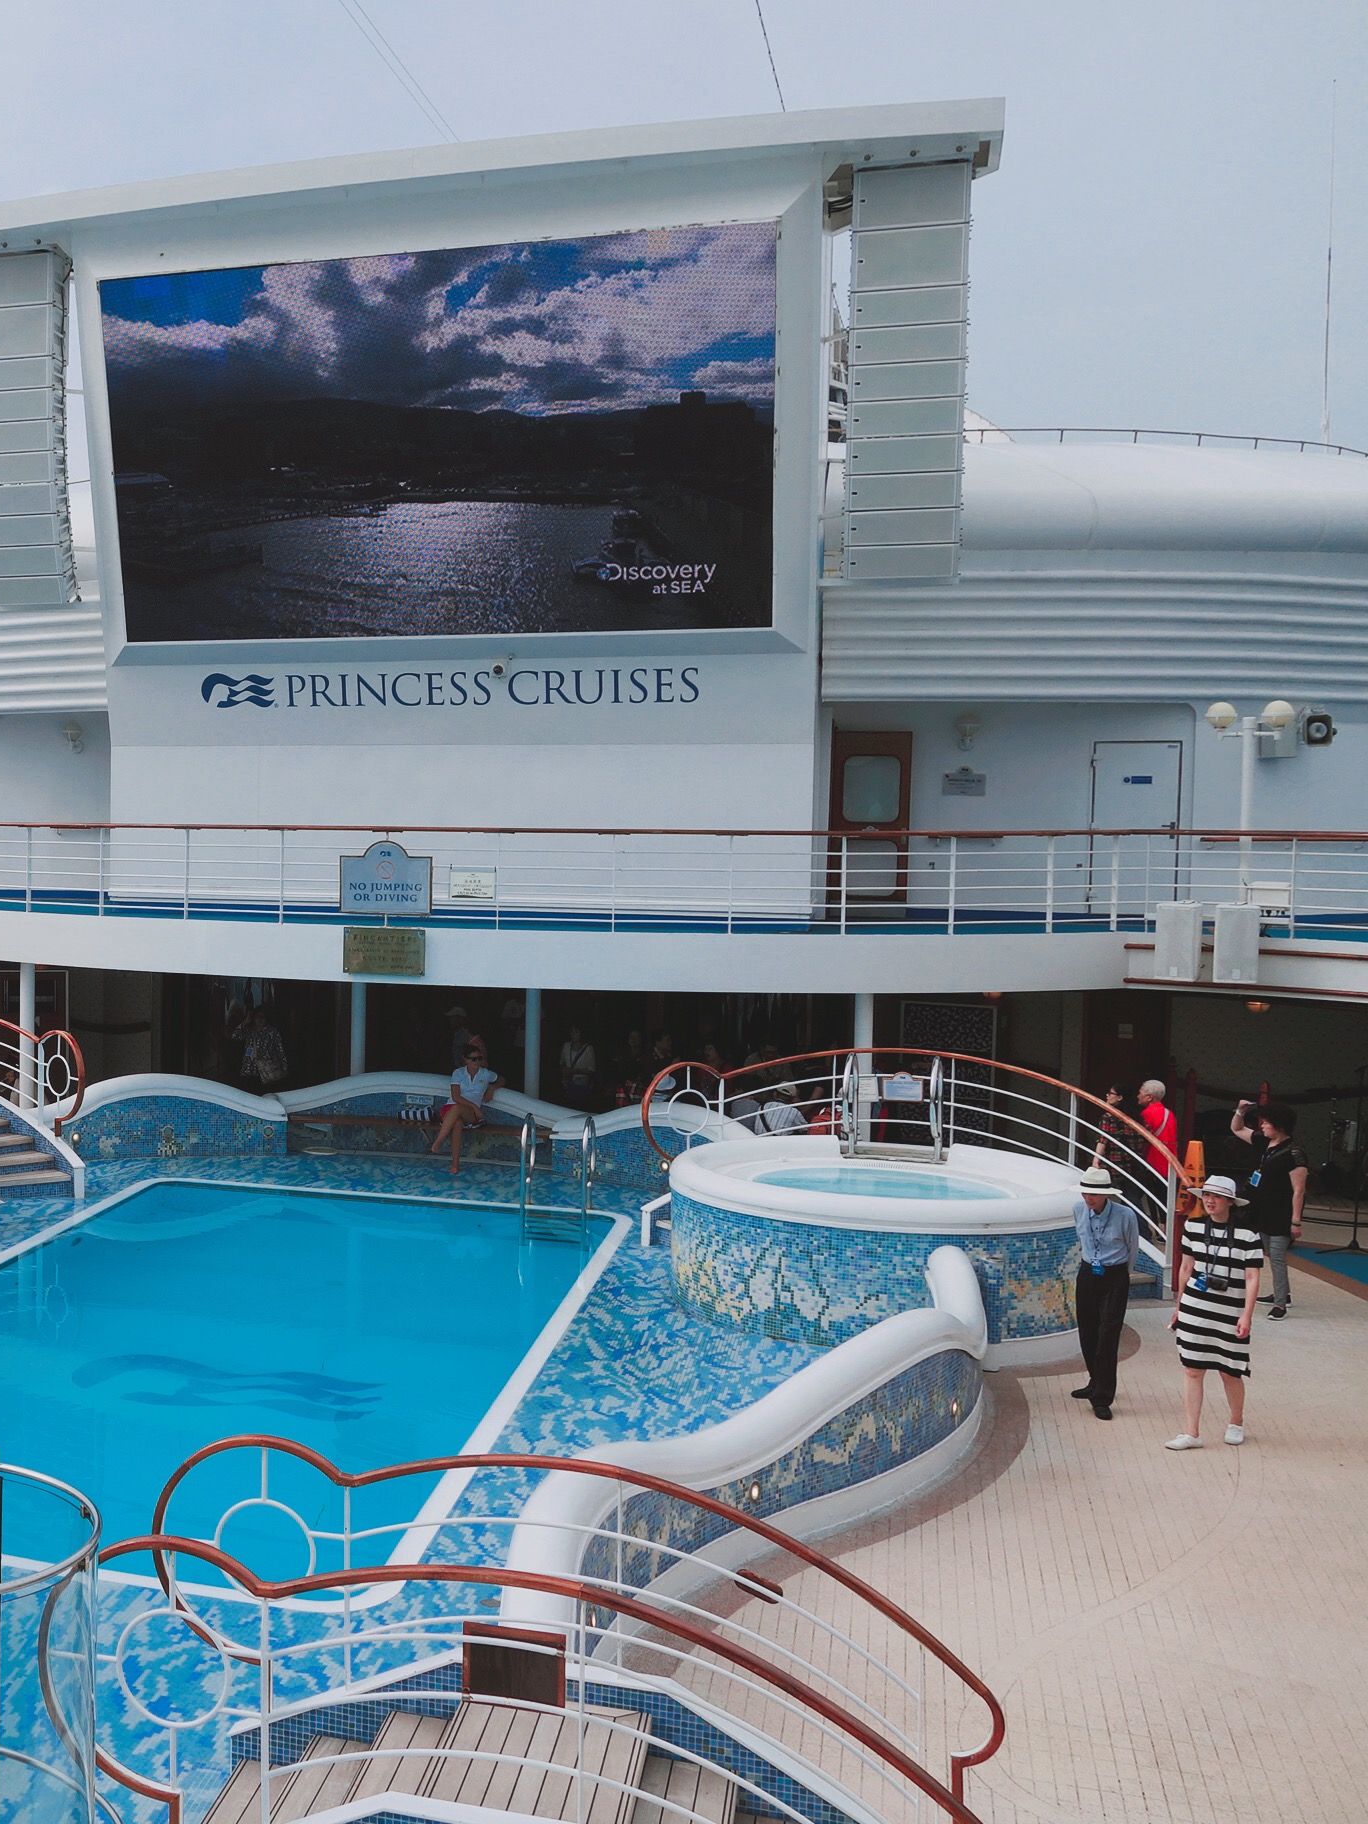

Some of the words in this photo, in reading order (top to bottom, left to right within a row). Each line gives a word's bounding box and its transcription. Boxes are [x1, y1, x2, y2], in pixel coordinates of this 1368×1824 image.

[605, 563, 717, 583] Discovery
[652, 584, 667, 594] at
[671, 580, 706, 593] SEA
[285, 671, 492, 707] PRINCESS
[507, 667, 700, 705] CRUISES
[349, 882, 367, 891] NO
[370, 882, 423, 892] JUMPING
[353, 893, 371, 901] OR
[375, 893, 418, 903] DIVING
